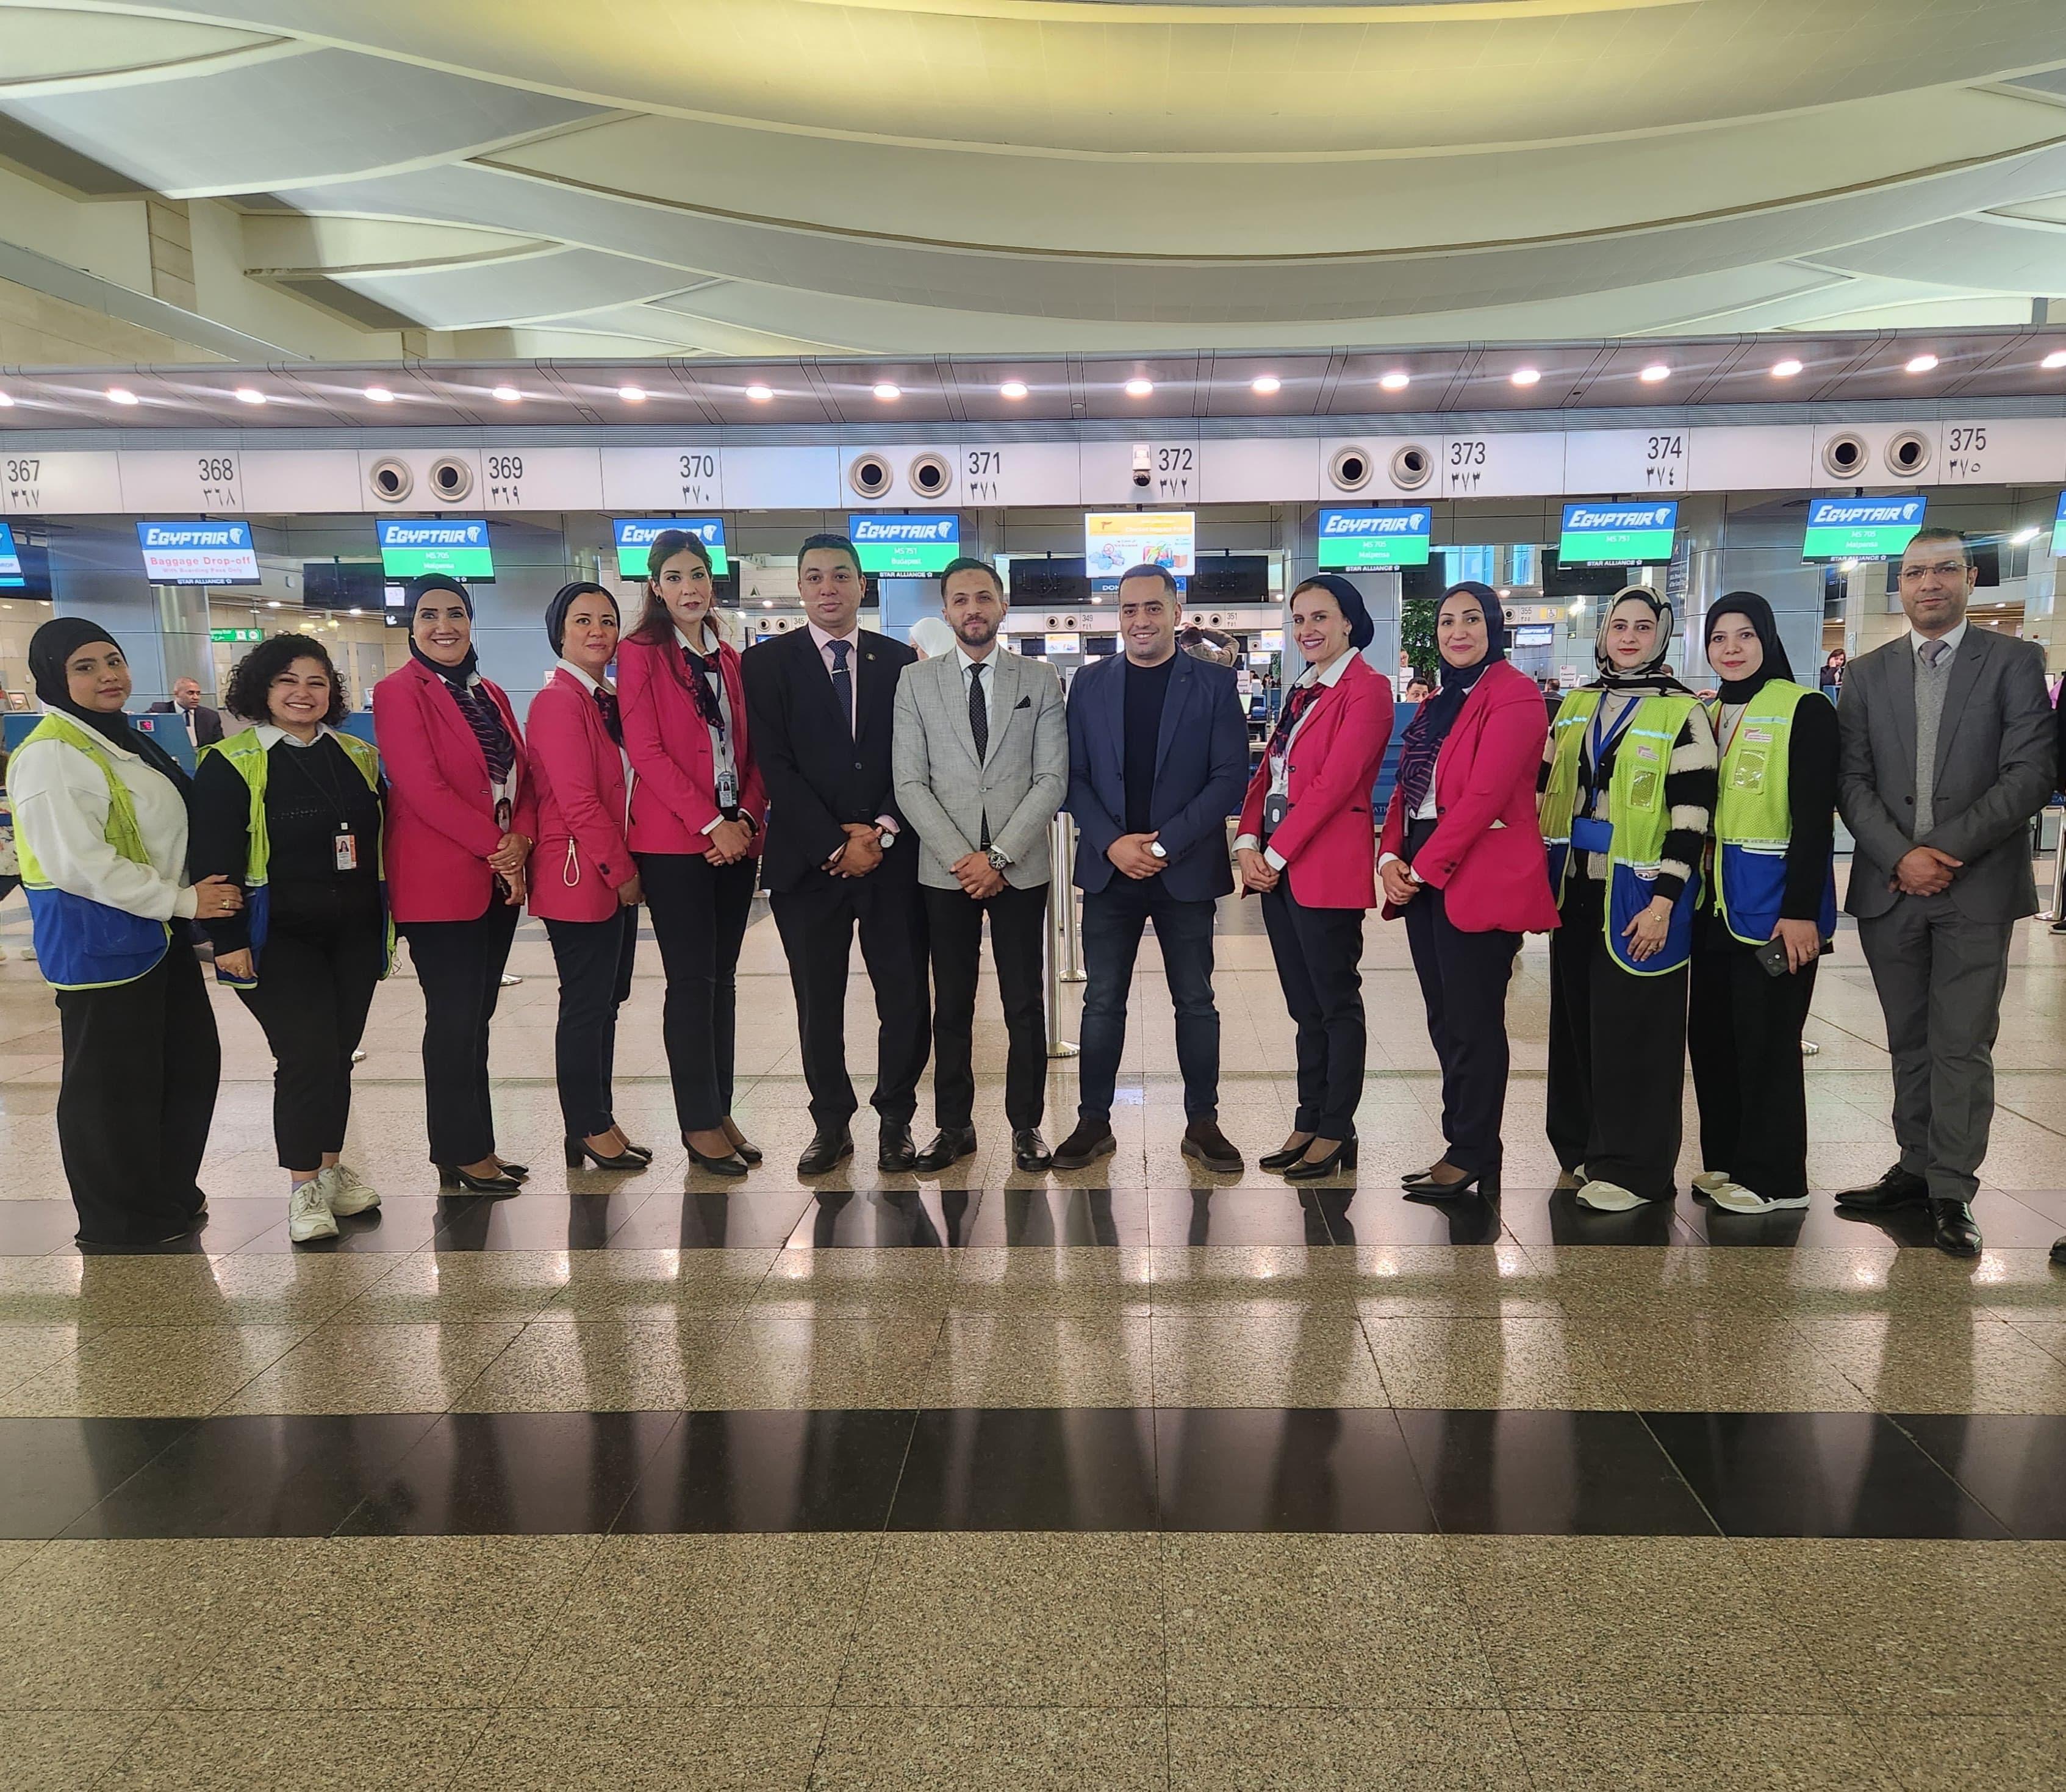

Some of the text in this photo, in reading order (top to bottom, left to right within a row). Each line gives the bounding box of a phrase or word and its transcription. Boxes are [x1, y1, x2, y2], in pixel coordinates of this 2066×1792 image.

[1648, 435, 1682, 459] 374
[1949, 428, 1987, 451] 375
[969, 451, 1000, 475] 371
[1159, 448, 1192, 471] 372
[1451, 442, 1485, 465] 373
[7, 460, 40, 482] 367
[199, 459, 233, 481] 368
[489, 456, 523, 479] 369
[680, 455, 714, 478] 370
[1324, 515, 1408, 533] EGYPTAIR
[1568, 510, 1655, 528] EGYPTAIR
[1813, 504, 1903, 523] EGYPTAIR
[146, 528, 229, 546] EGYPTAIR
[385, 526, 466, 543] EGYPTAIR
[855, 521, 937, 539] EGYPTAIR
[150, 556, 251, 567] Baggage Drop-off
